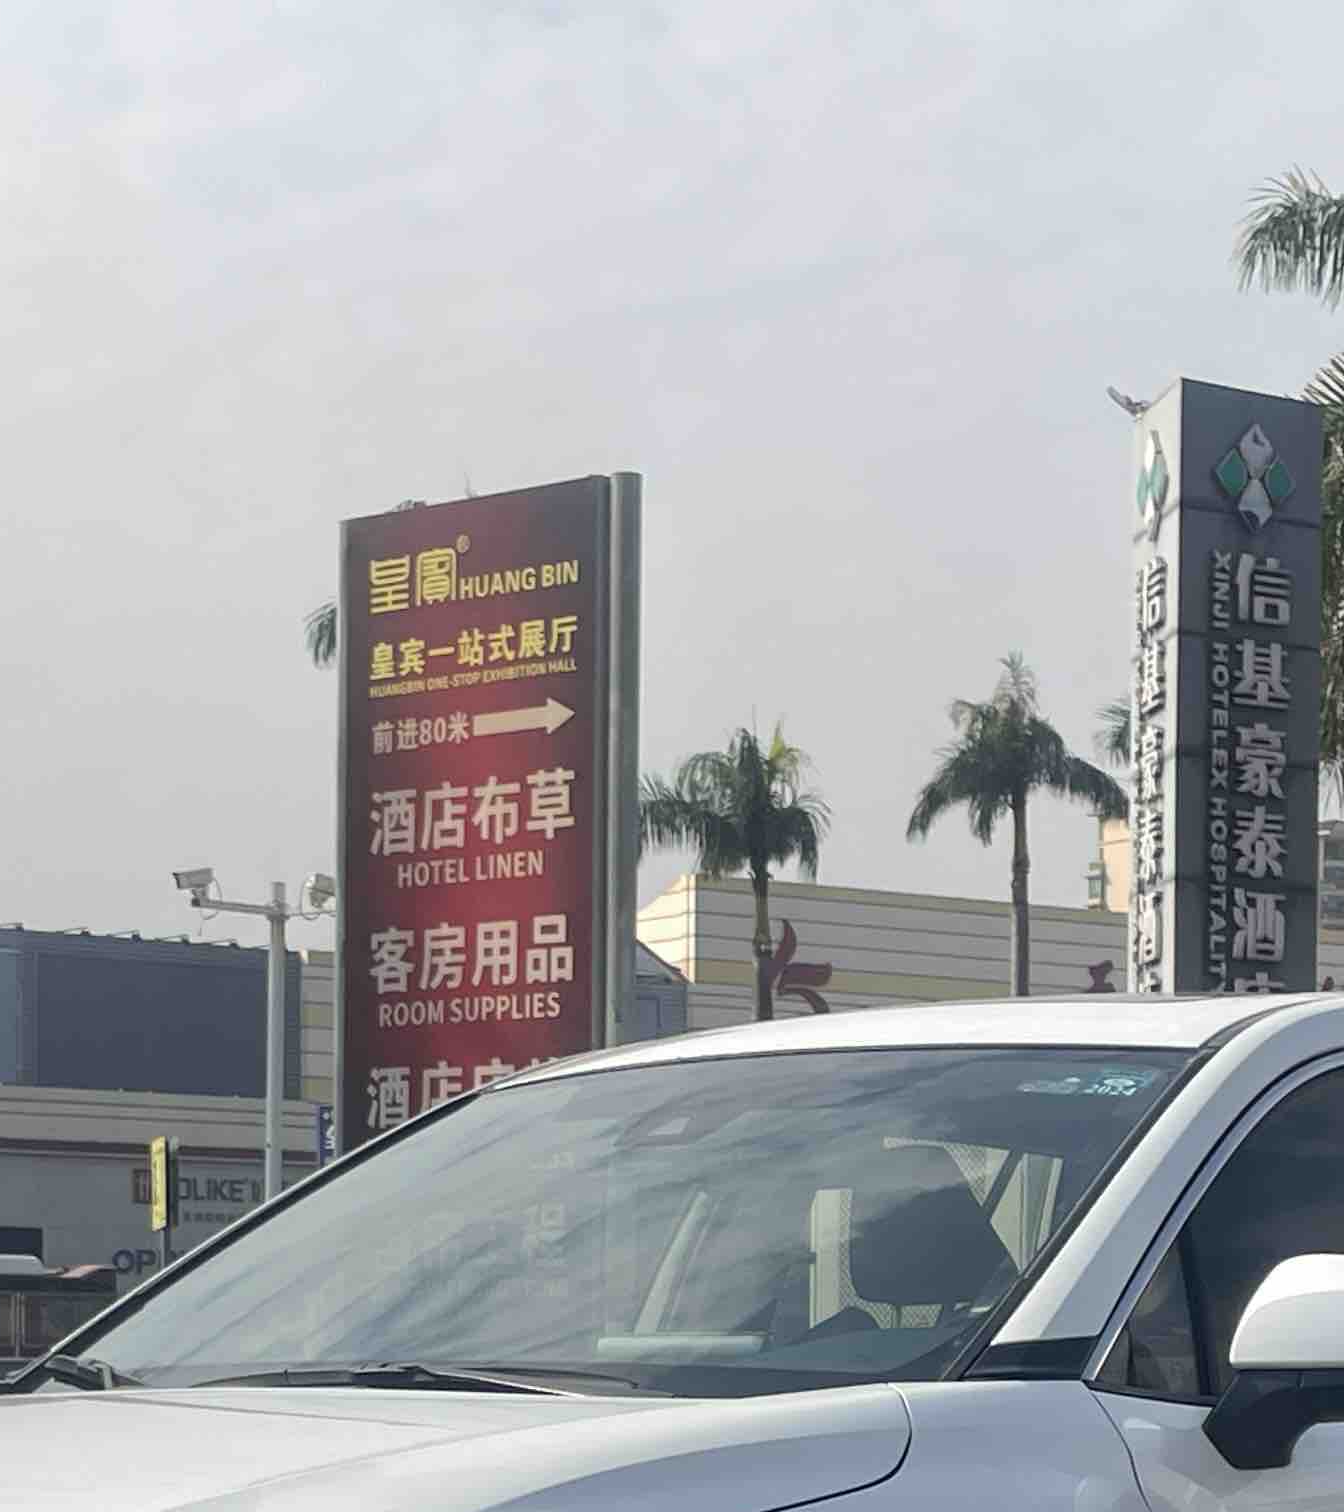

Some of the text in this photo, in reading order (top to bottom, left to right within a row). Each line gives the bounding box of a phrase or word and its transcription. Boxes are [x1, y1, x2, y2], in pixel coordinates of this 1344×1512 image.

[459, 560, 579, 600] HUANG BIN
[1211, 550, 1233, 630] XINJI
[369, 615, 578, 681] 皇宾一站式展厅
[369, 657, 578, 698] HUANGBIN ONE-STOP EXHIBITION HALL
[371, 711, 471, 755] 前进80米
[1209, 642, 1233, 788] HOTELEX
[369, 768, 576, 856] 酒店布草
[397, 850, 544, 889] HOTEL LINEN
[369, 914, 574, 995] 客房用品
[378, 992, 561, 1028] ROOM SUPPLIES
